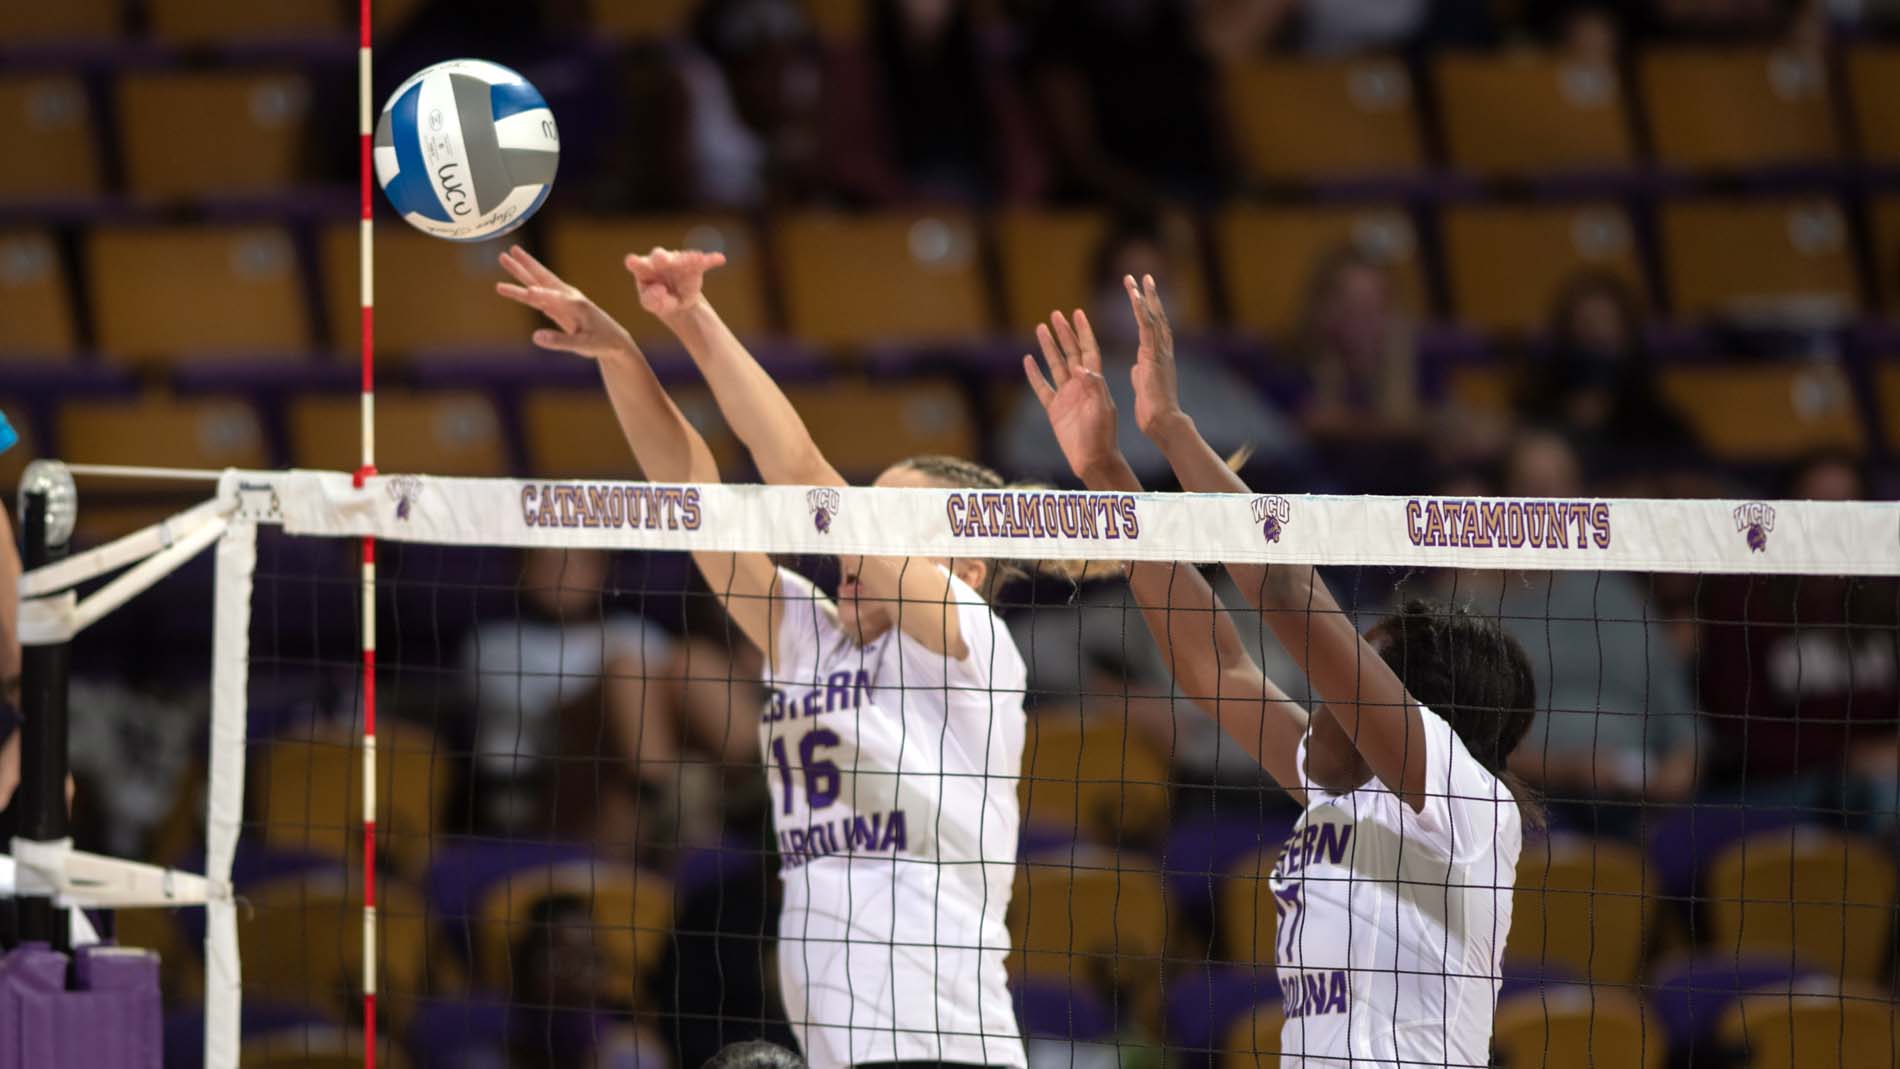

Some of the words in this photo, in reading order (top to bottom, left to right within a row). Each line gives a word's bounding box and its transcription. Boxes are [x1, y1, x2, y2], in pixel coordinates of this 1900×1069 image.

[438, 163, 471, 216] WCU
[520, 484, 702, 530] CATAMOUNTS
[806, 487, 841, 516] WCU
[947, 493, 1139, 539] CATAMOUNTS
[1251, 496, 1290, 523] WCU
[1406, 499, 1612, 549] CATAMOUNTS
[1733, 502, 1776, 533] WCU
[772, 728, 841, 815] 16
